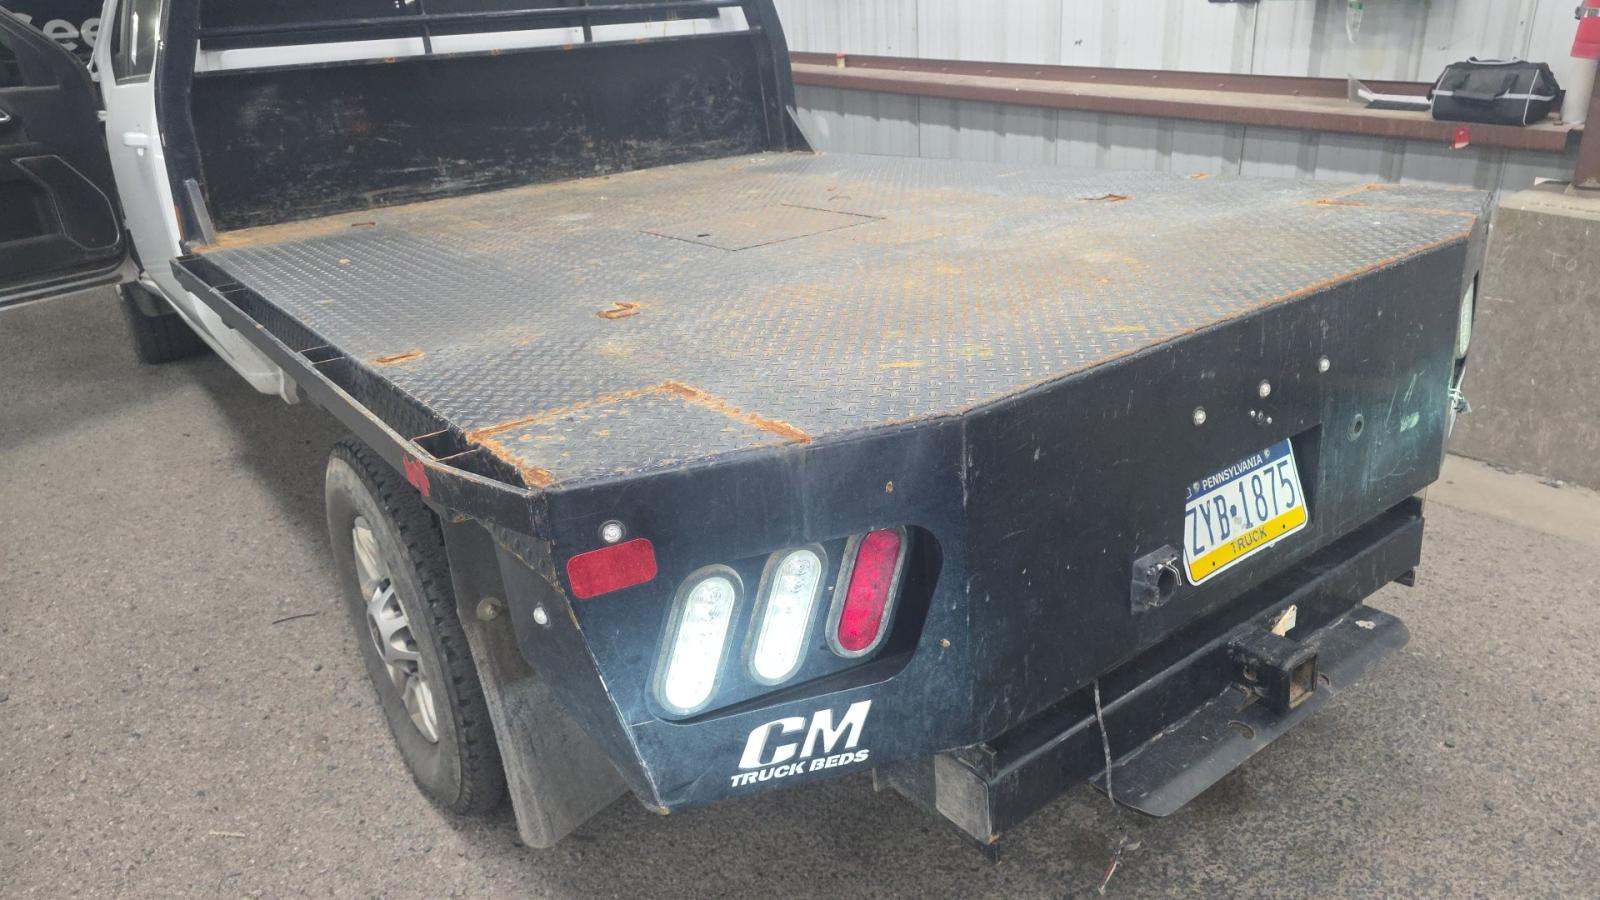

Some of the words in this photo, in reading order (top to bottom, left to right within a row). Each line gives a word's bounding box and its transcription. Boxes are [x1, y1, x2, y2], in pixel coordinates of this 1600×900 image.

[1202, 454, 1263, 490] PENNSYLVANIA
[1230, 527, 1268, 554] TRUCK
[738, 700, 872, 769] CM
[730, 761, 806, 788] TRUCK
[809, 749, 870, 772] BEDS
